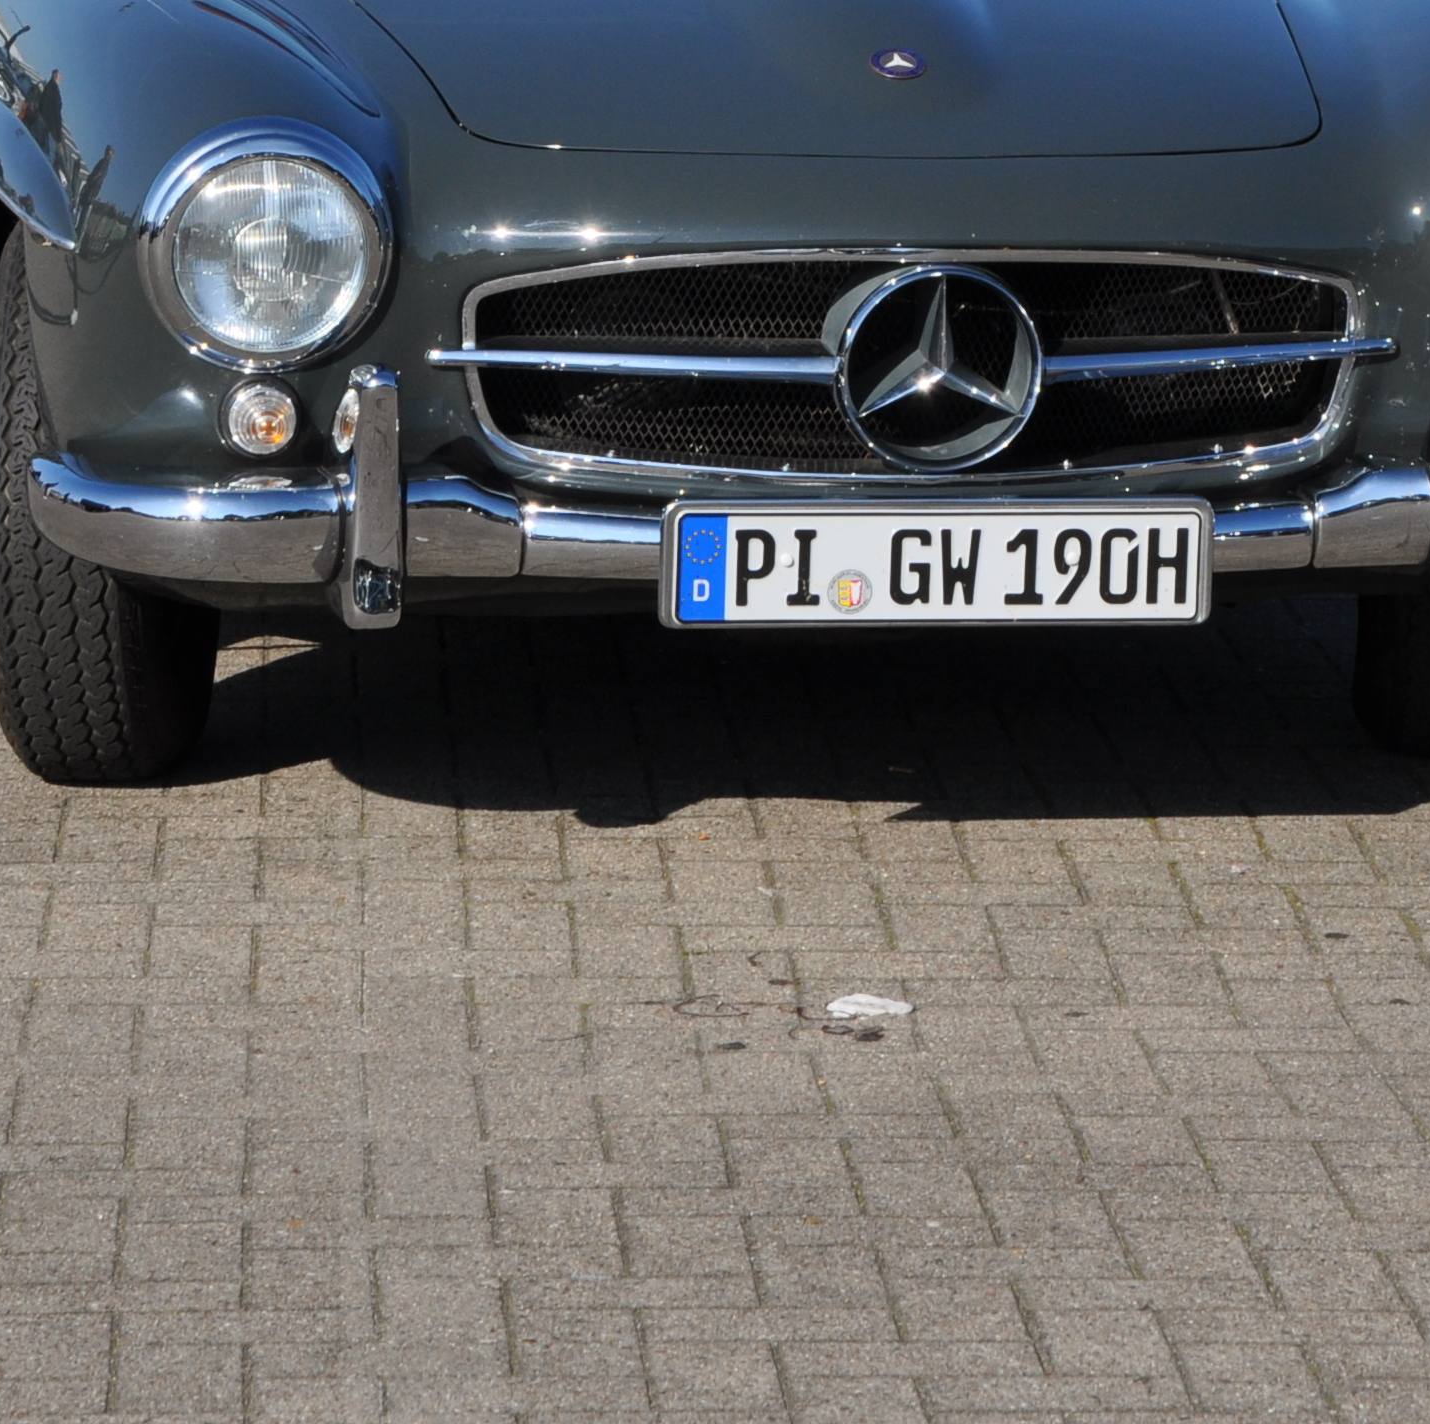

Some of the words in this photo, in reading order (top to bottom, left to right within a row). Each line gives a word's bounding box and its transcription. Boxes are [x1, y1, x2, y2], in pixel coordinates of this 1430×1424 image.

[692, 578, 710, 601] D
[734, 529, 820, 607] PI
[889, 528, 982, 606] GW
[1004, 527, 1190, 606] 190H
